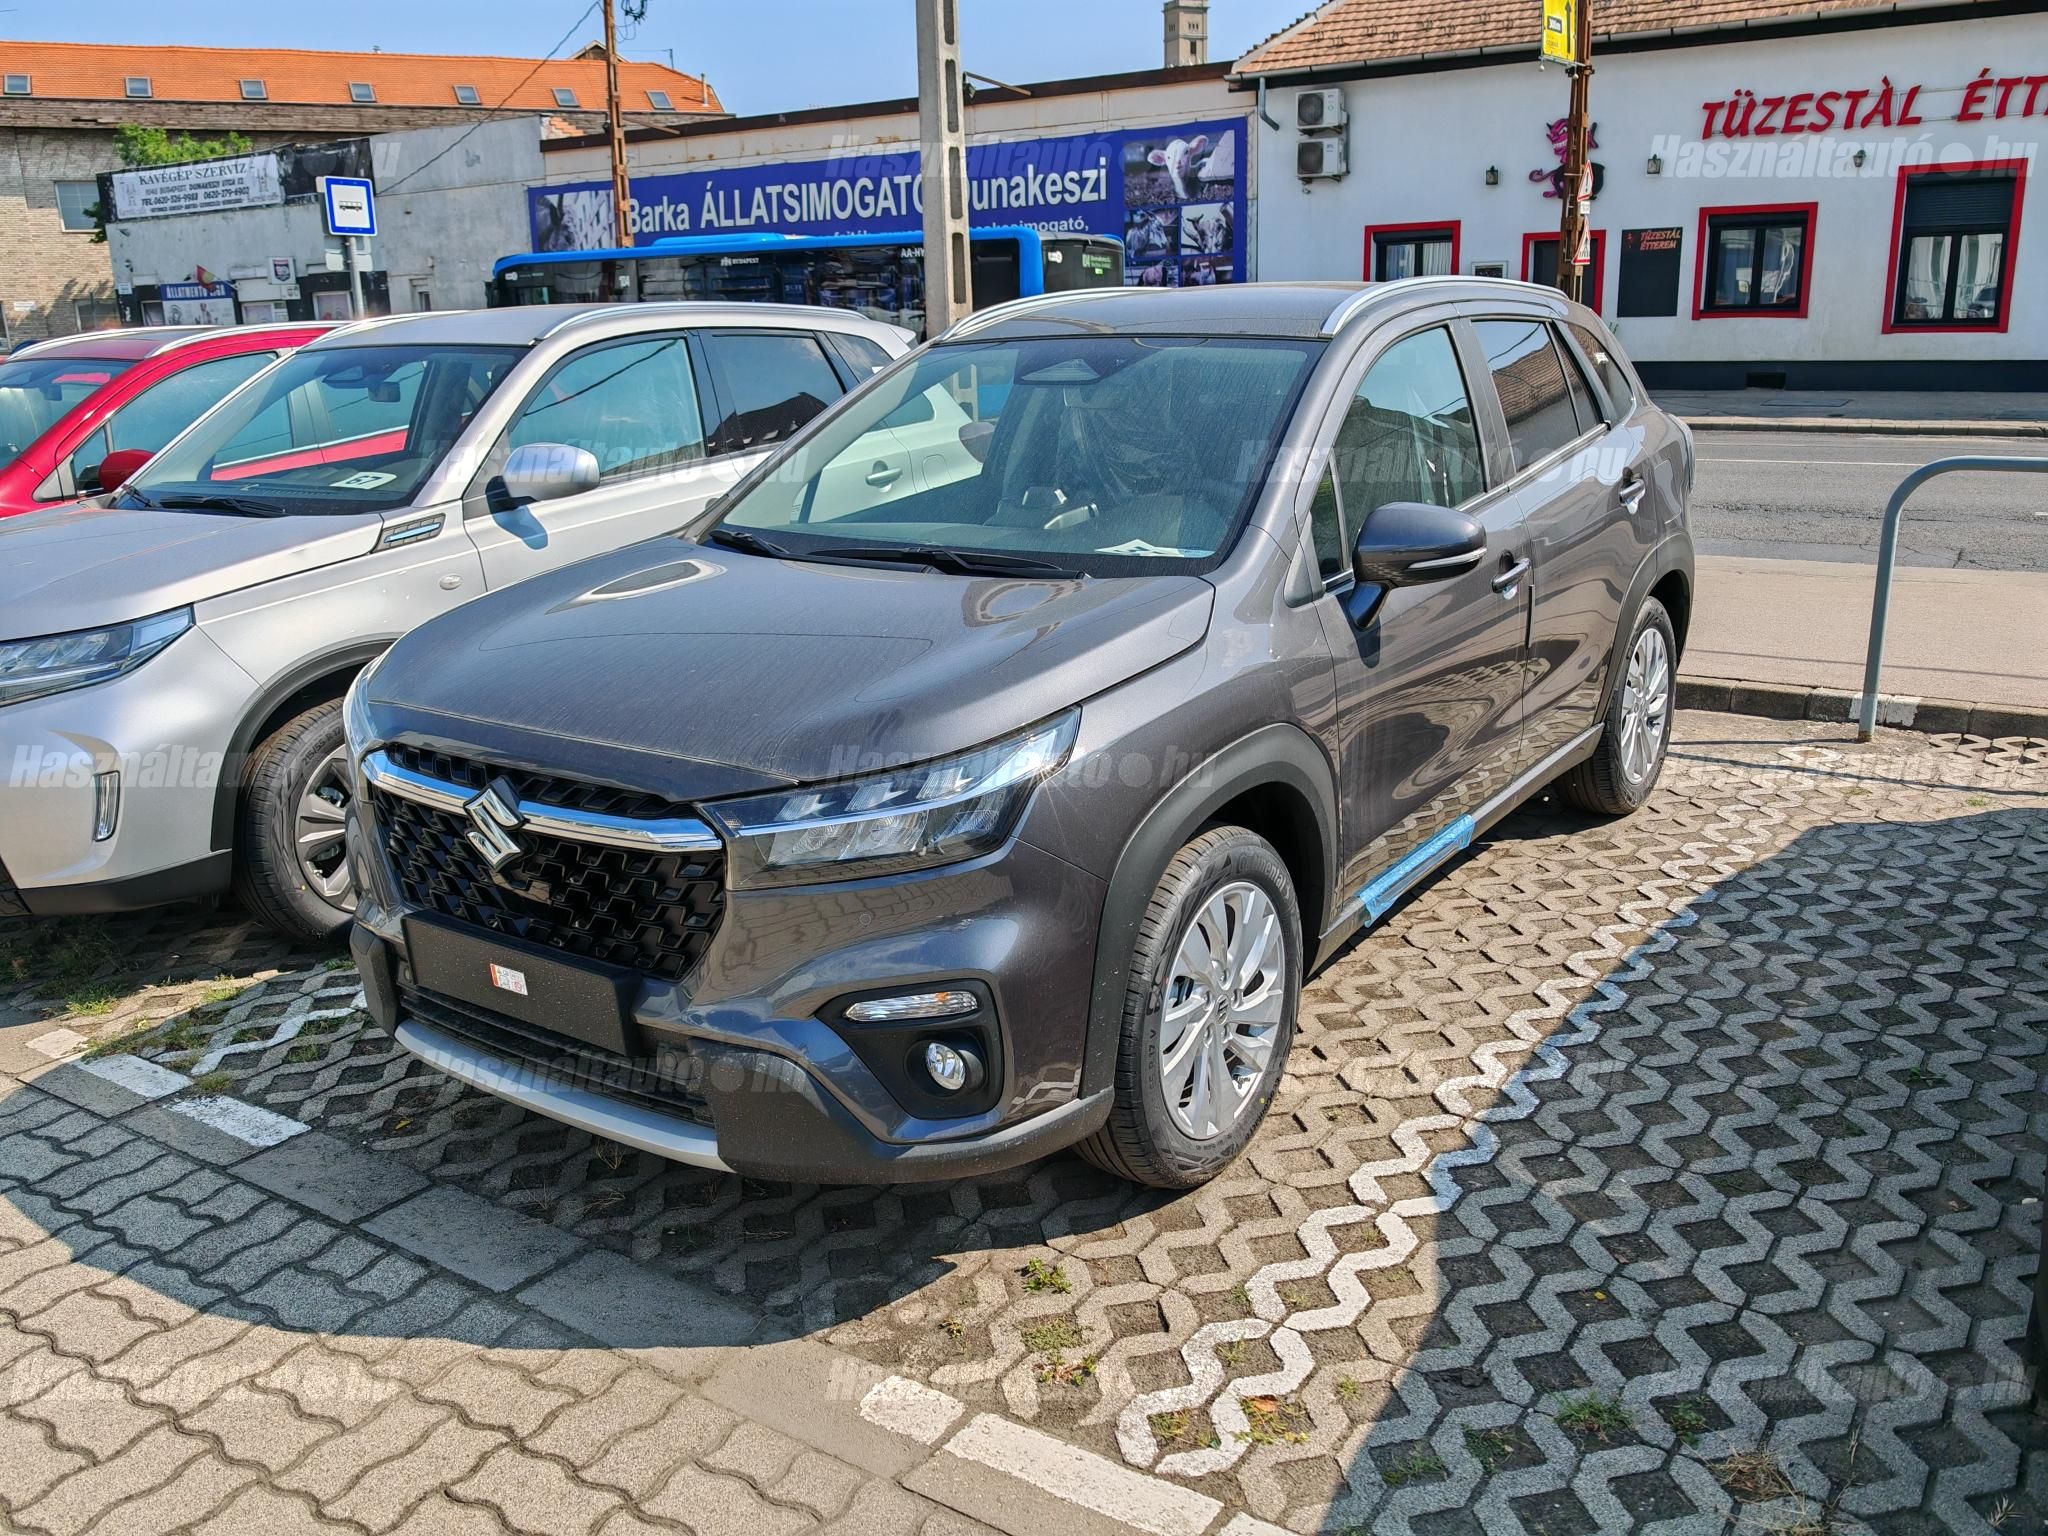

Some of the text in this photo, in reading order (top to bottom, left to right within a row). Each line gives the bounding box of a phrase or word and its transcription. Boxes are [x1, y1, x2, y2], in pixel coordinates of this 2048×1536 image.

[1957, 67, 2048, 121] ÉTT
[629, 195, 690, 234] Barka
[966, 155, 1108, 211] unakeszi
[1640, 239, 1677, 251] ÉTTEREM
